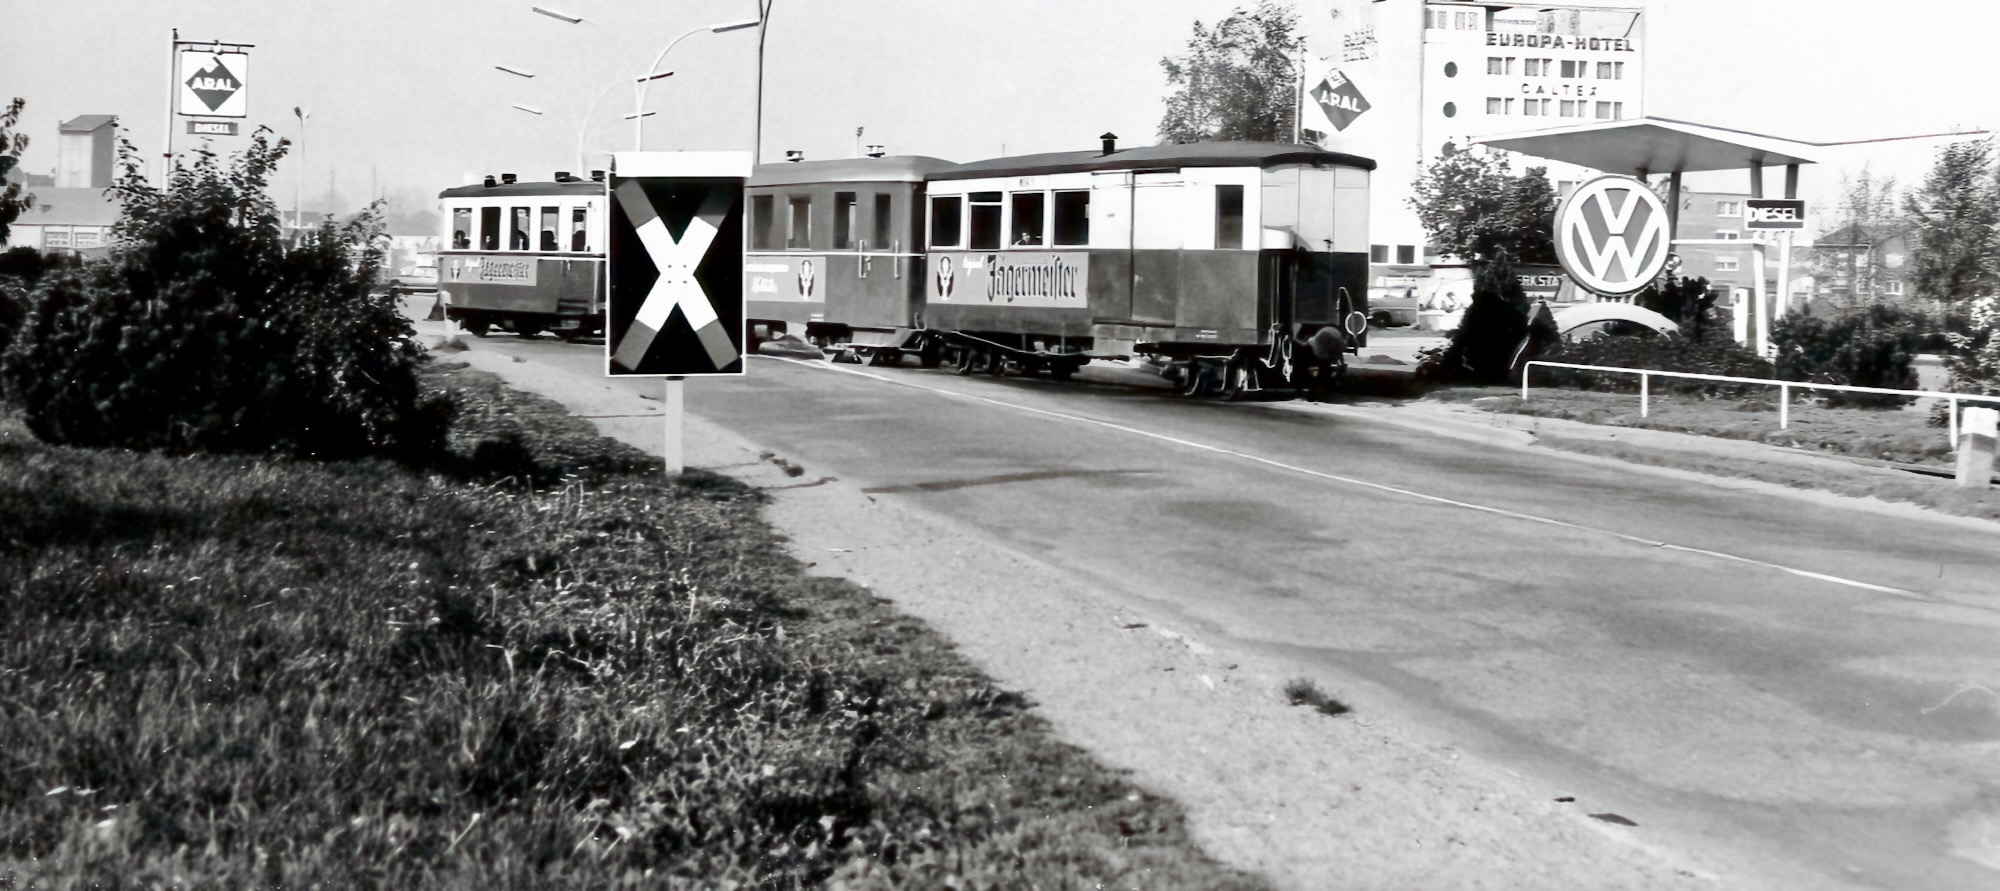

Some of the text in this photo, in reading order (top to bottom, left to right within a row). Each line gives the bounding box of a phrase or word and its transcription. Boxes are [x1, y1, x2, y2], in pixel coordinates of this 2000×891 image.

[1486, 33, 1635, 52] EUROPA-HOTEL
[191, 76, 237, 92] ARAL
[1319, 89, 1362, 113] ARAL
[1747, 207, 1803, 222] DIESEL
[1516, 274, 1562, 287] ERKSTA
